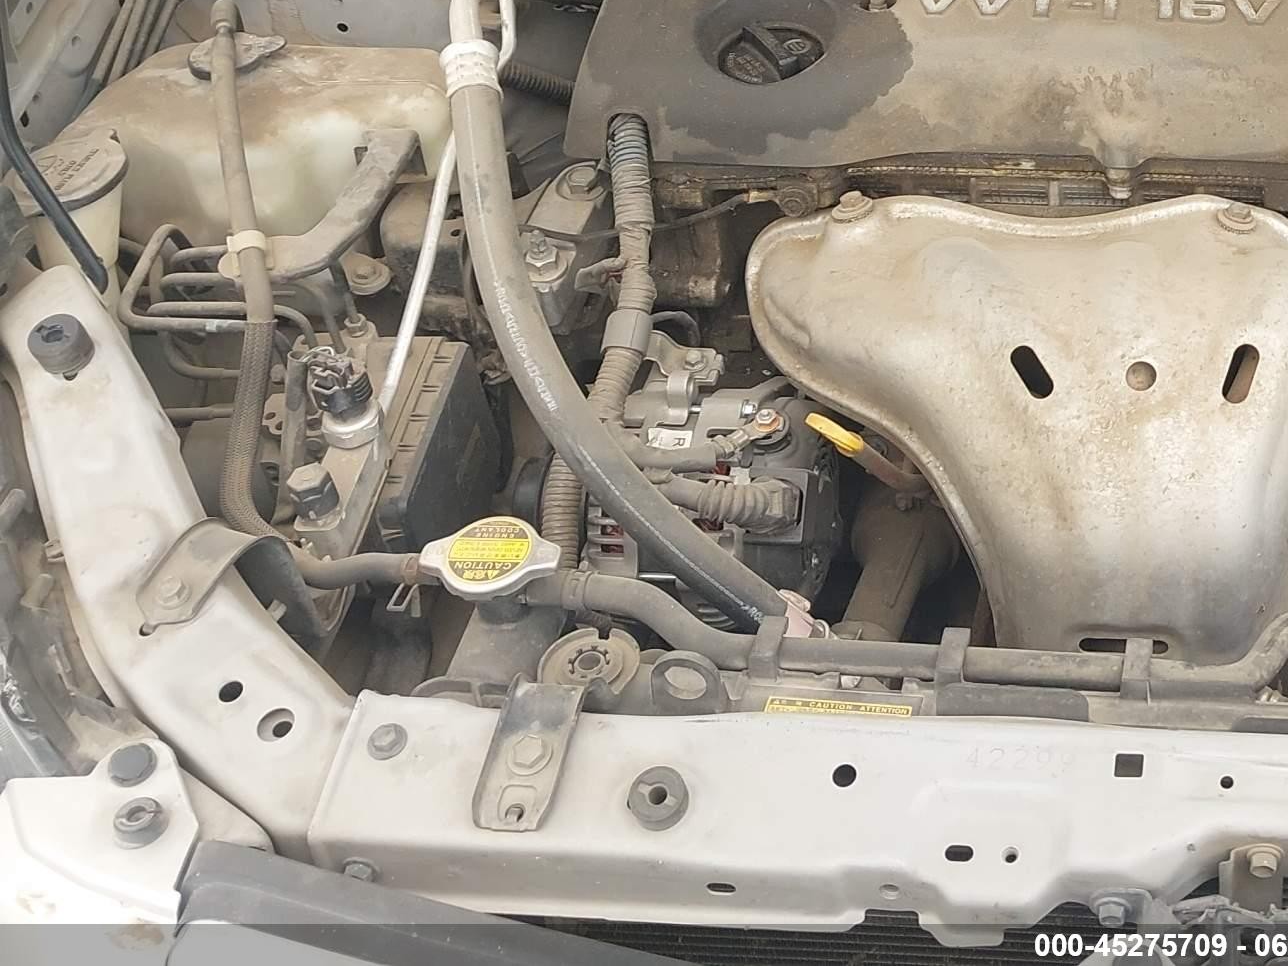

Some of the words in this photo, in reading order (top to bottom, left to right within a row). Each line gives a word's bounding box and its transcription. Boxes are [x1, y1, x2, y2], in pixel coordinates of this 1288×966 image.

[454, 561, 512, 570] CAUTION
[809, 701, 853, 710] CAUTION
[859, 705, 908, 715] ATTENTION
